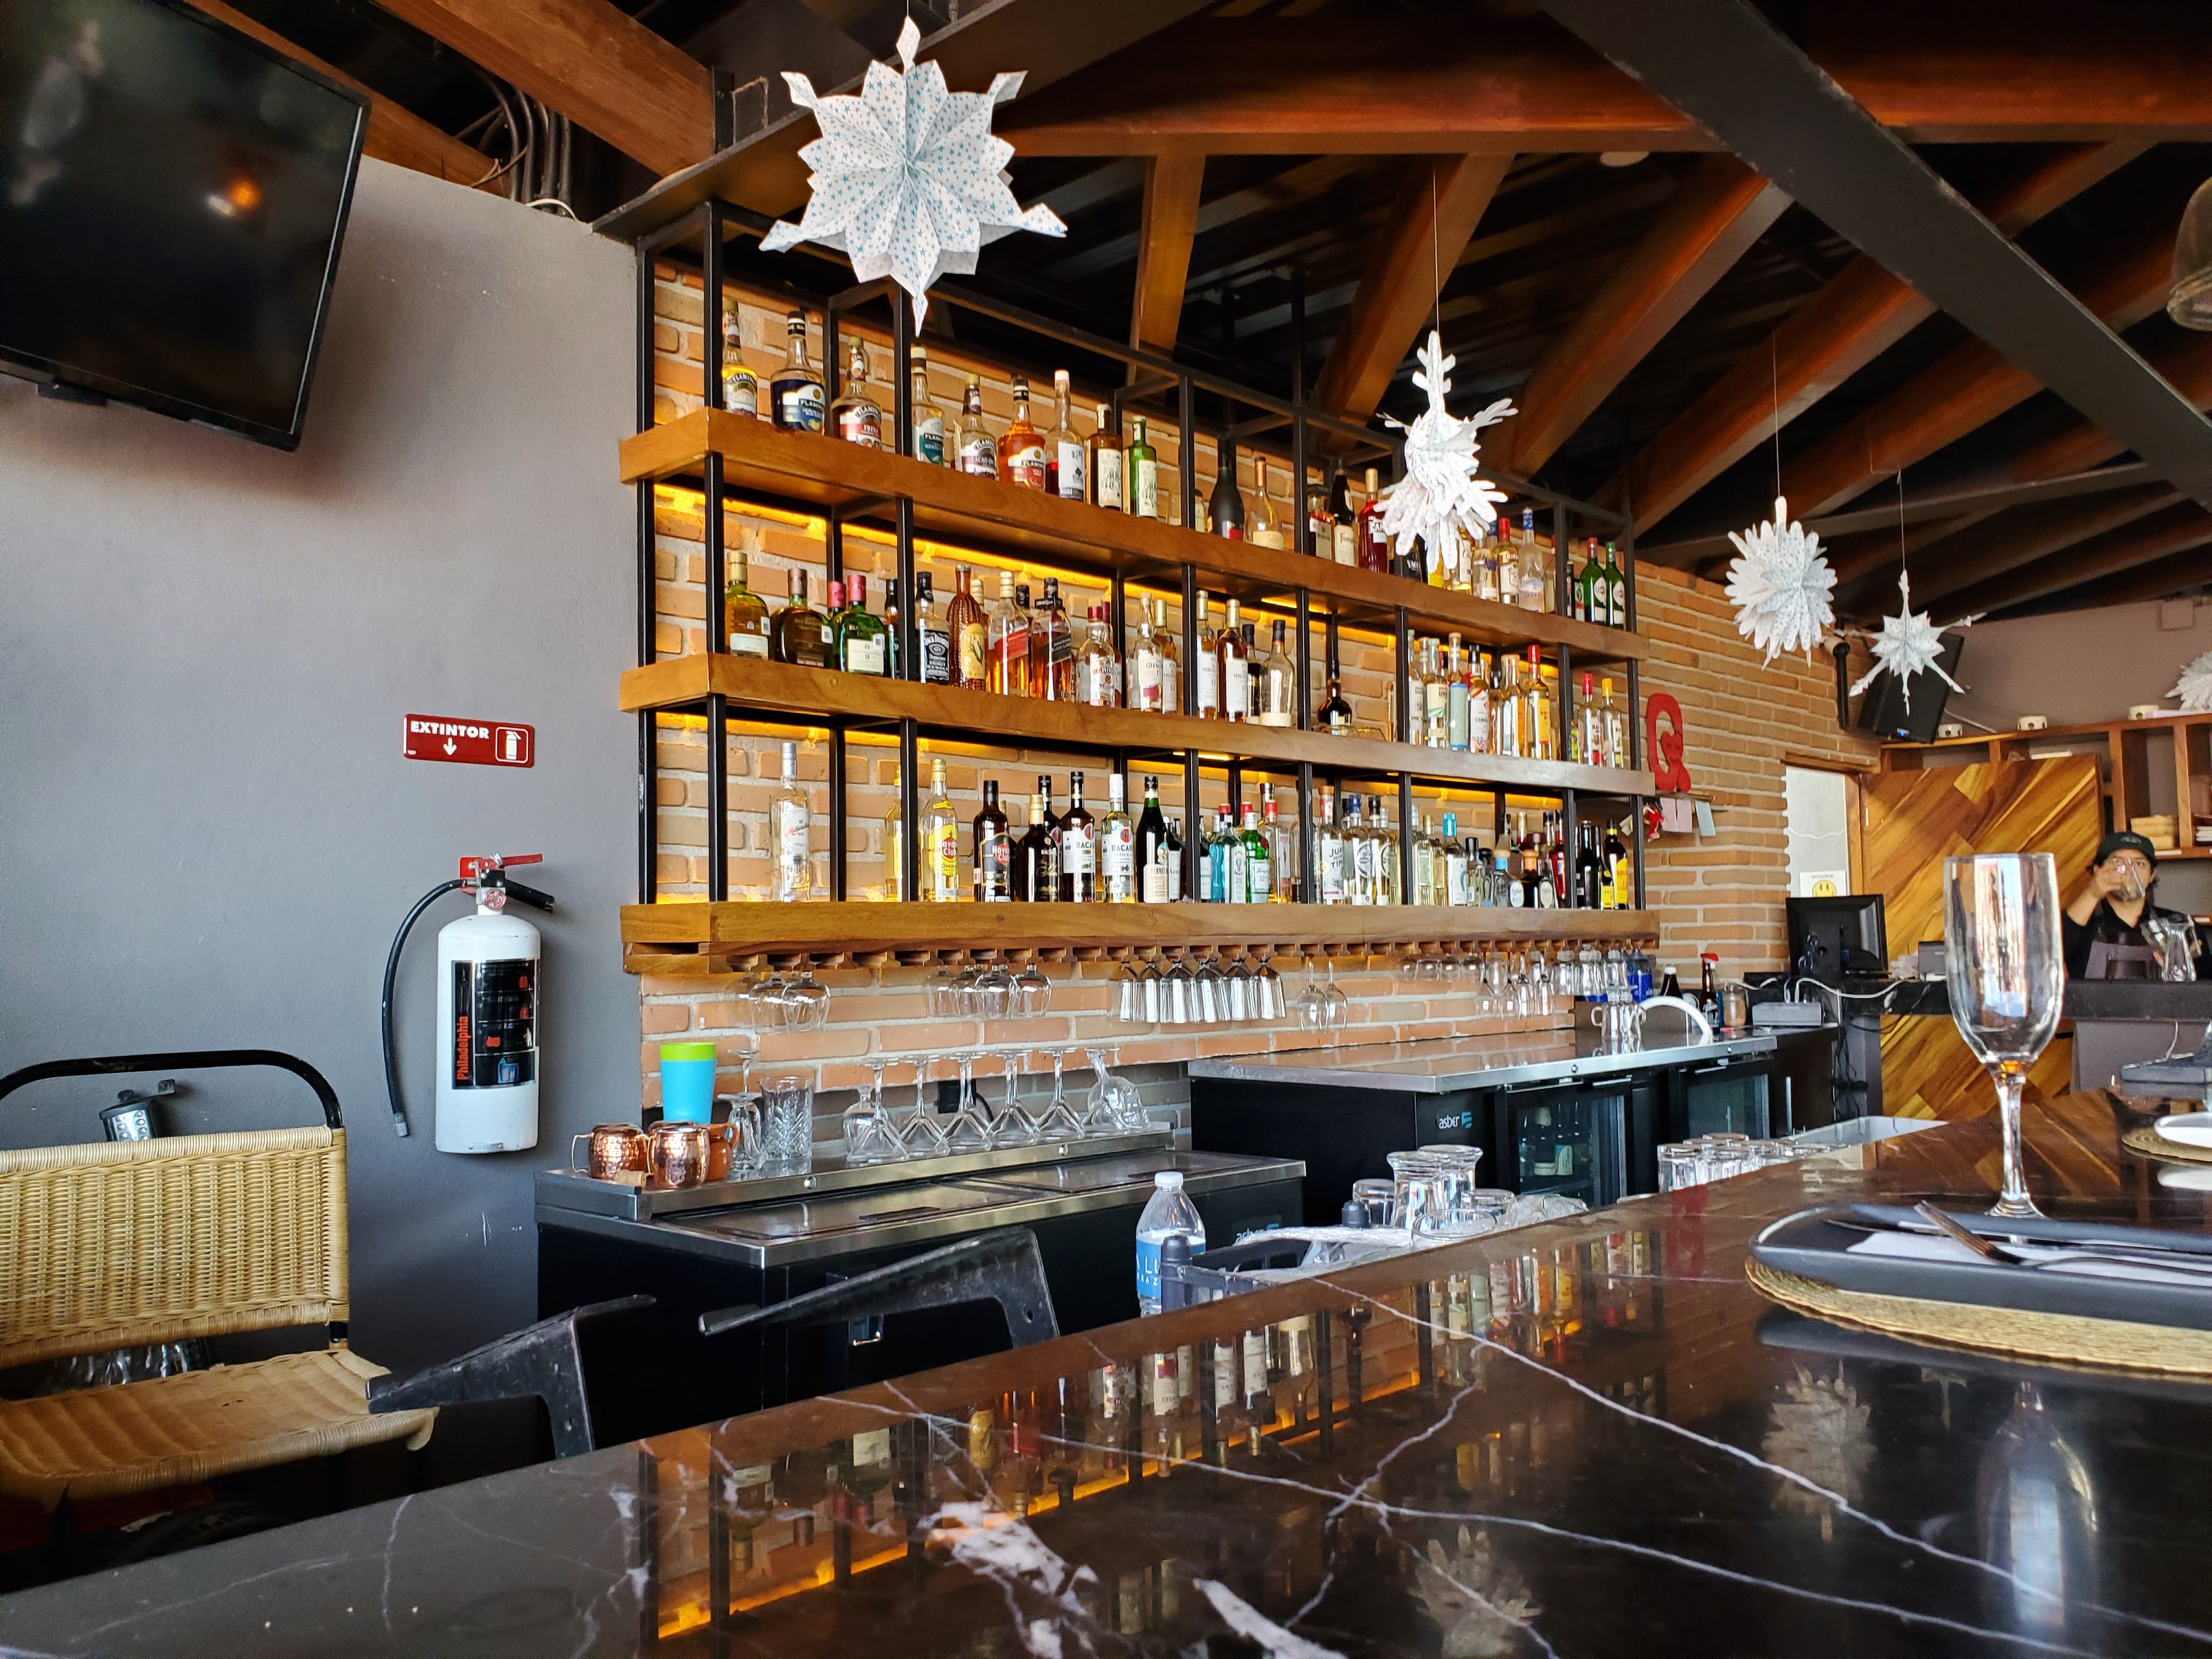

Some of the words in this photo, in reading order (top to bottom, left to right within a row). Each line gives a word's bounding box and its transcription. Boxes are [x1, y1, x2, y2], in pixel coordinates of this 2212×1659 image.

[410, 720, 489, 740] EXTINTOR
[943, 848, 957, 856] Club
[456, 1015, 472, 1080] Philadelphia
[1438, 1114, 1460, 1129] asber
